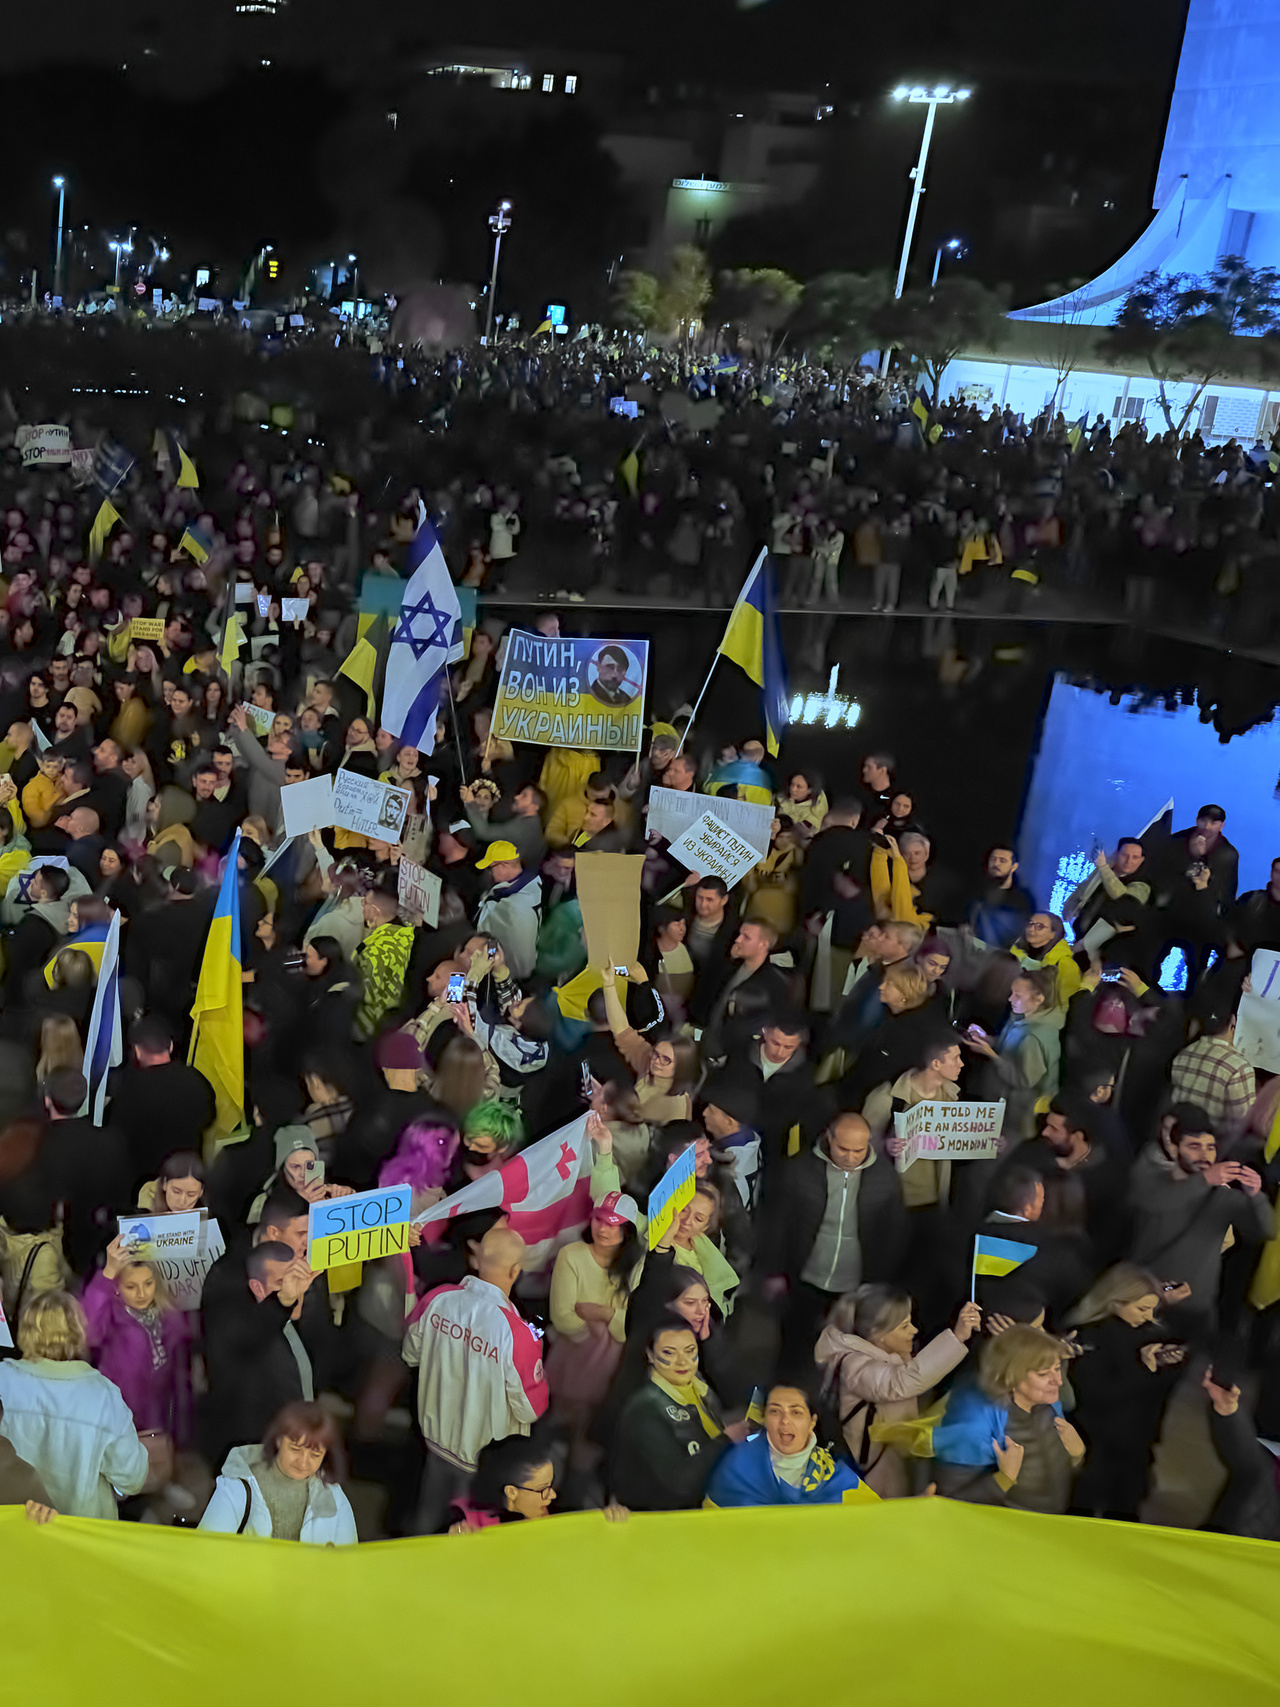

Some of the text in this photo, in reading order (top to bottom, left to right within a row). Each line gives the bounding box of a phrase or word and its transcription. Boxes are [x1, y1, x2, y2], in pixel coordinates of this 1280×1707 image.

[23, 446, 46, 461] STOP
[513, 635, 582, 673] ПУТИН,
[504, 670, 581, 708] ВОН ИЗ
[499, 705, 639, 746] УКРАИНЫ!
[683, 837, 697, 851] ИЗ
[699, 831, 740, 867] УБИРАЙСЯ
[702, 814, 731, 841] ФАШИСТ
[726, 837, 755, 863] ПУТИН
[401, 858, 426, 883] STOP
[400, 878, 430, 913] PUTIN
[935, 1122, 949, 1132] AN
[951, 1121, 996, 1133] ASSHOLE
[941, 1106, 971, 1118] TOLD
[976, 1107, 996, 1119] ME
[947, 1139, 969, 1151] MOM
[325, 1196, 403, 1236] STOP
[650, 1190, 666, 1235] NO
[156, 1236, 194, 1248] UKRAINE
[327, 1223, 405, 1266] PUTIN
[430, 1313, 499, 1364] GEORGIA
